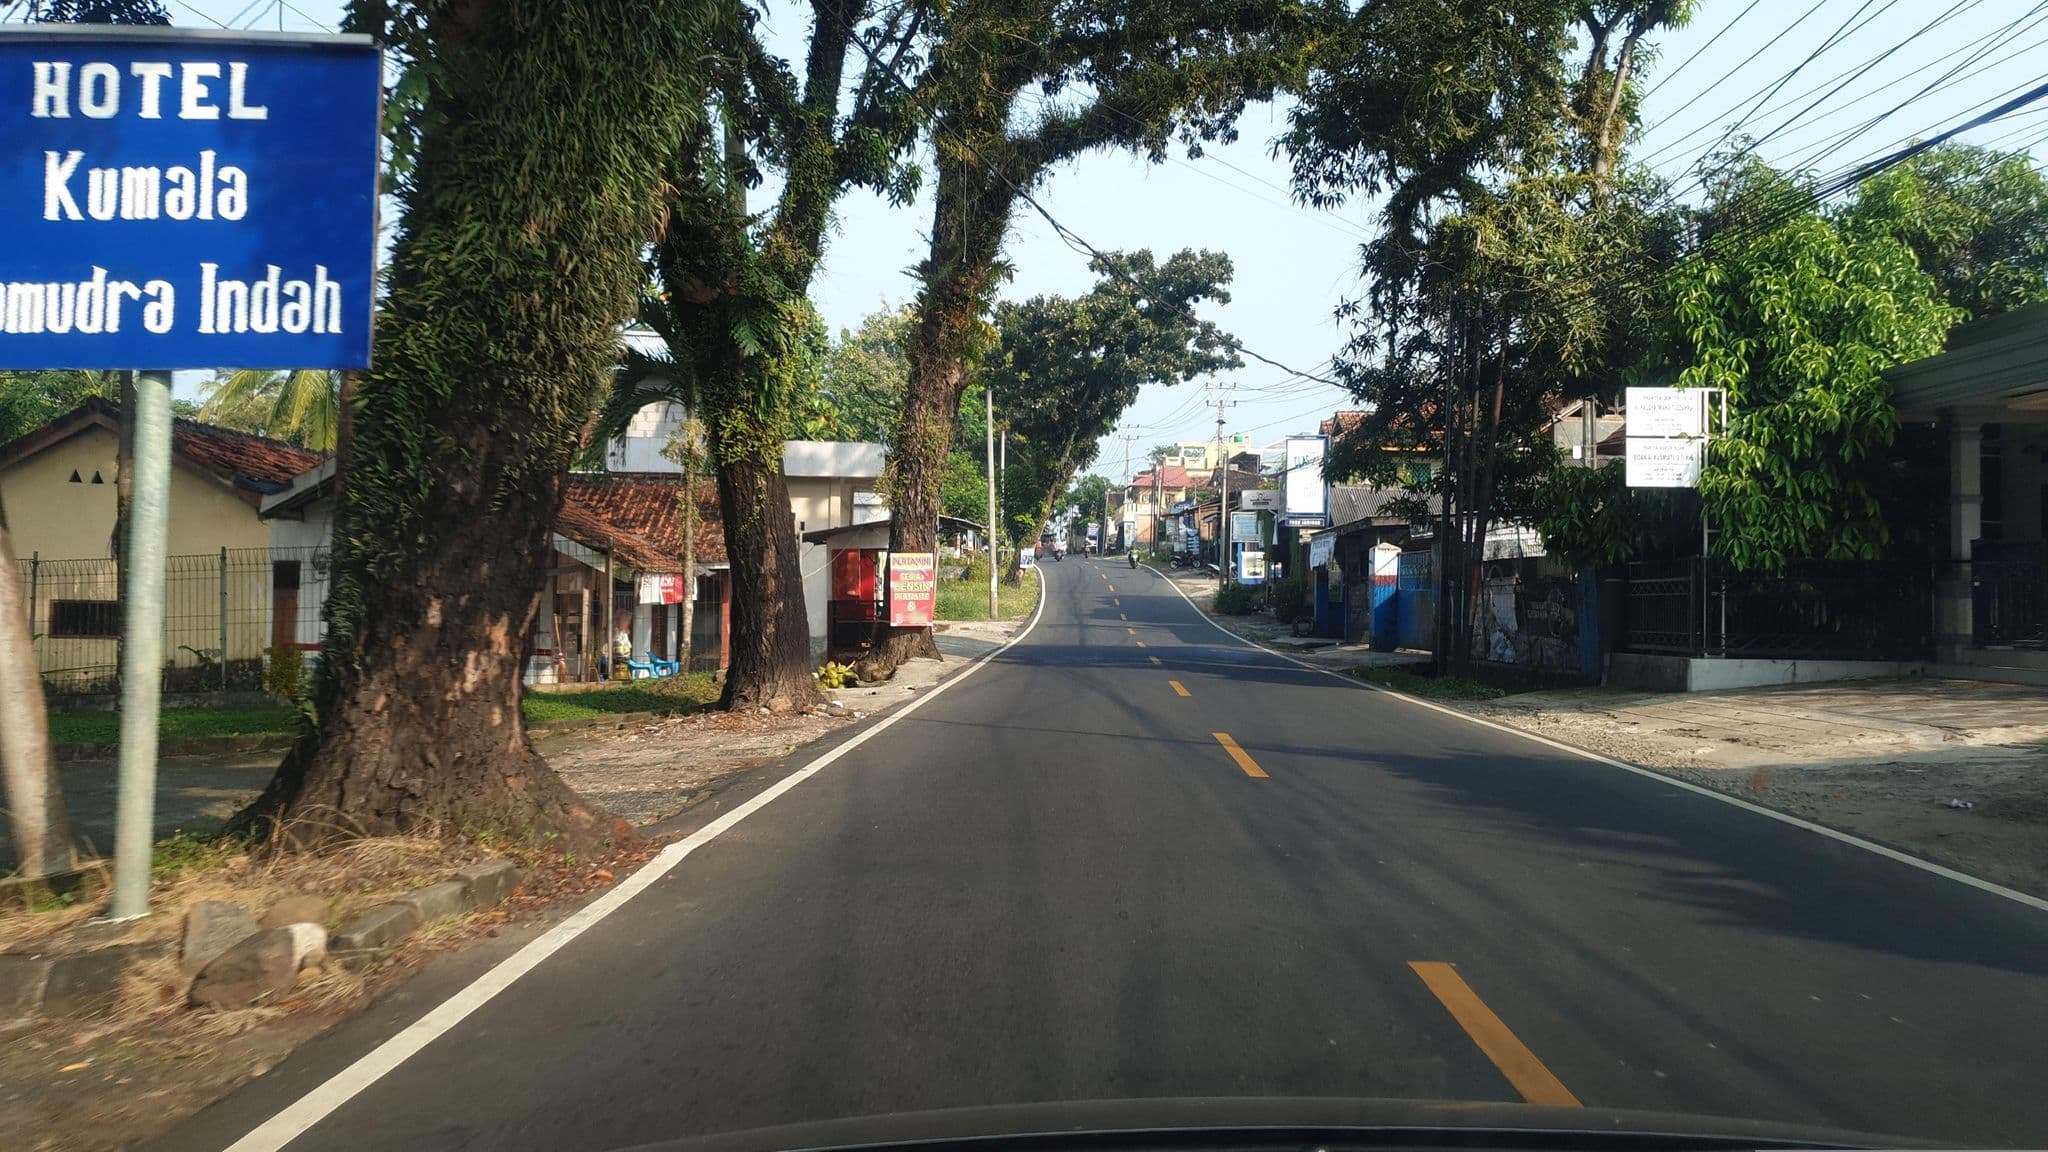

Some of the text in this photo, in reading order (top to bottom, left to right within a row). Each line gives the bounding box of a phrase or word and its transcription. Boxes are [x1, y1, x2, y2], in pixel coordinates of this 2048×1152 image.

[31, 61, 268, 120] HOTEL
[43, 150, 248, 221] Kumala
[0, 263, 343, 334] mudra Indah
